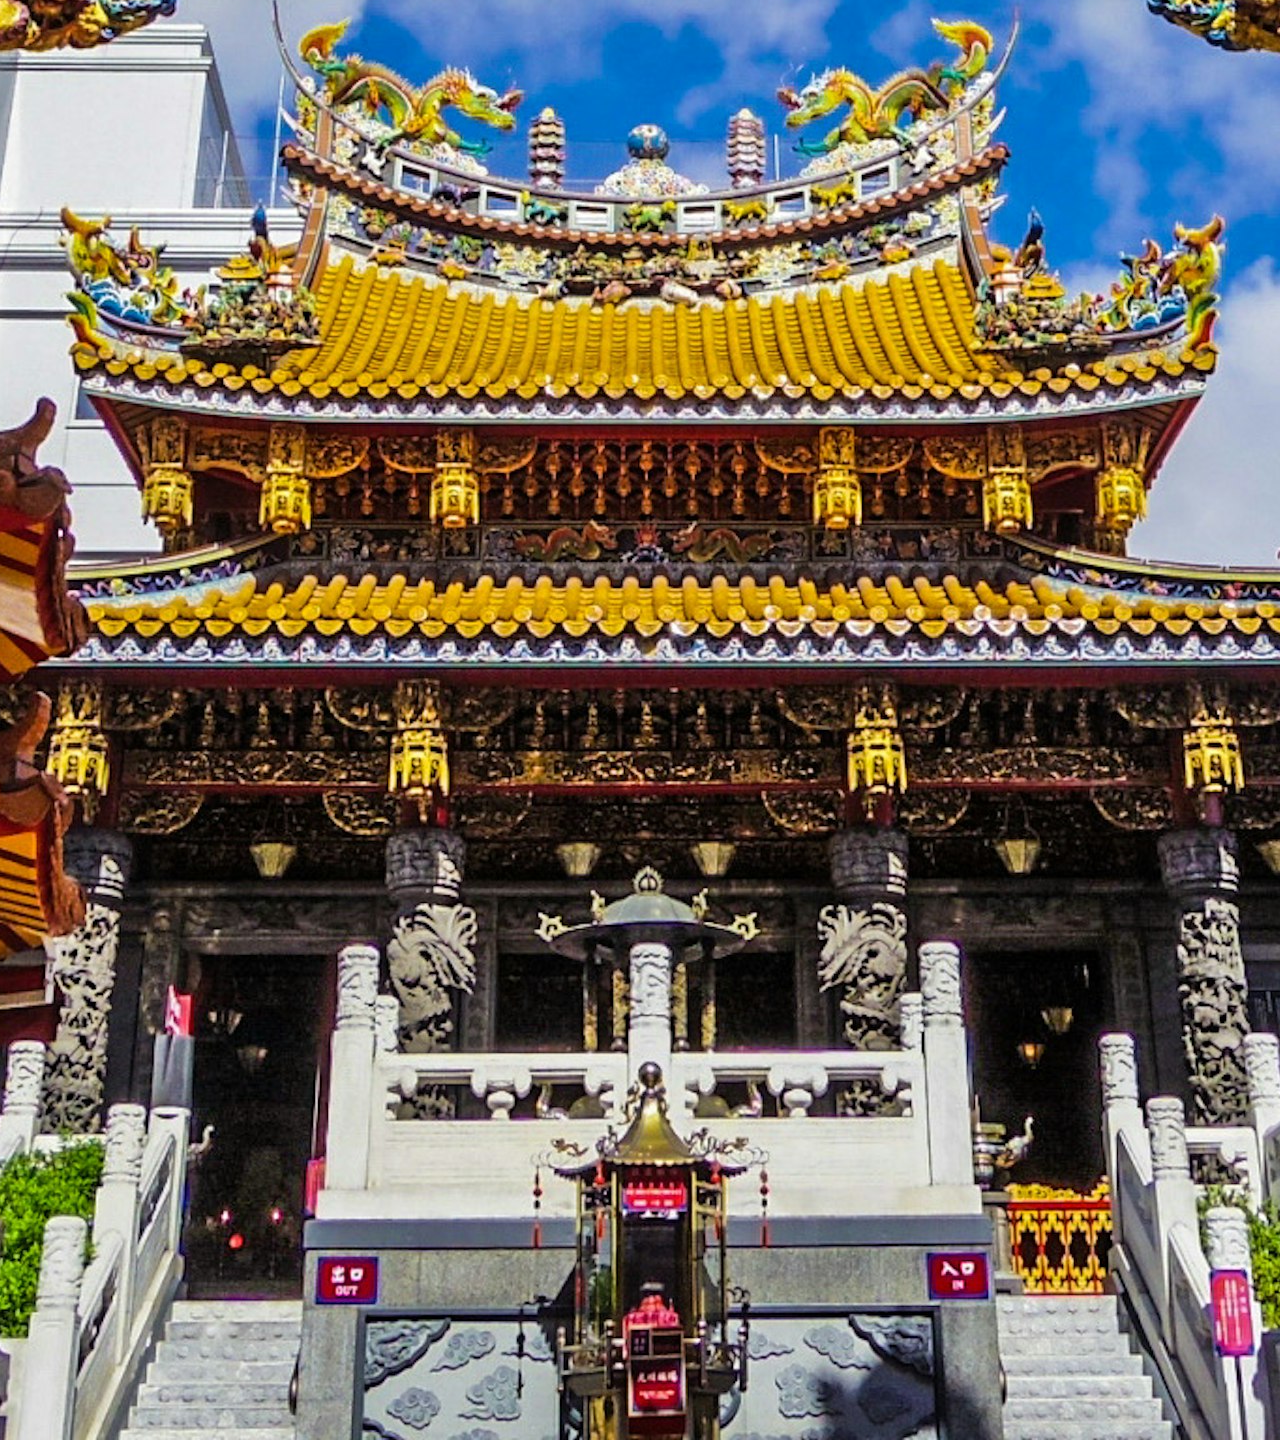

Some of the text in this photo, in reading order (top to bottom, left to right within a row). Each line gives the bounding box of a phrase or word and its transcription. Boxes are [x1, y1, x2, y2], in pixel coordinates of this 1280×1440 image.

[331, 1265, 364, 1284] 出口
[941, 1260, 975, 1276] 入口
[335, 1285, 358, 1297] OUT
[952, 1279, 965, 1290] IN
